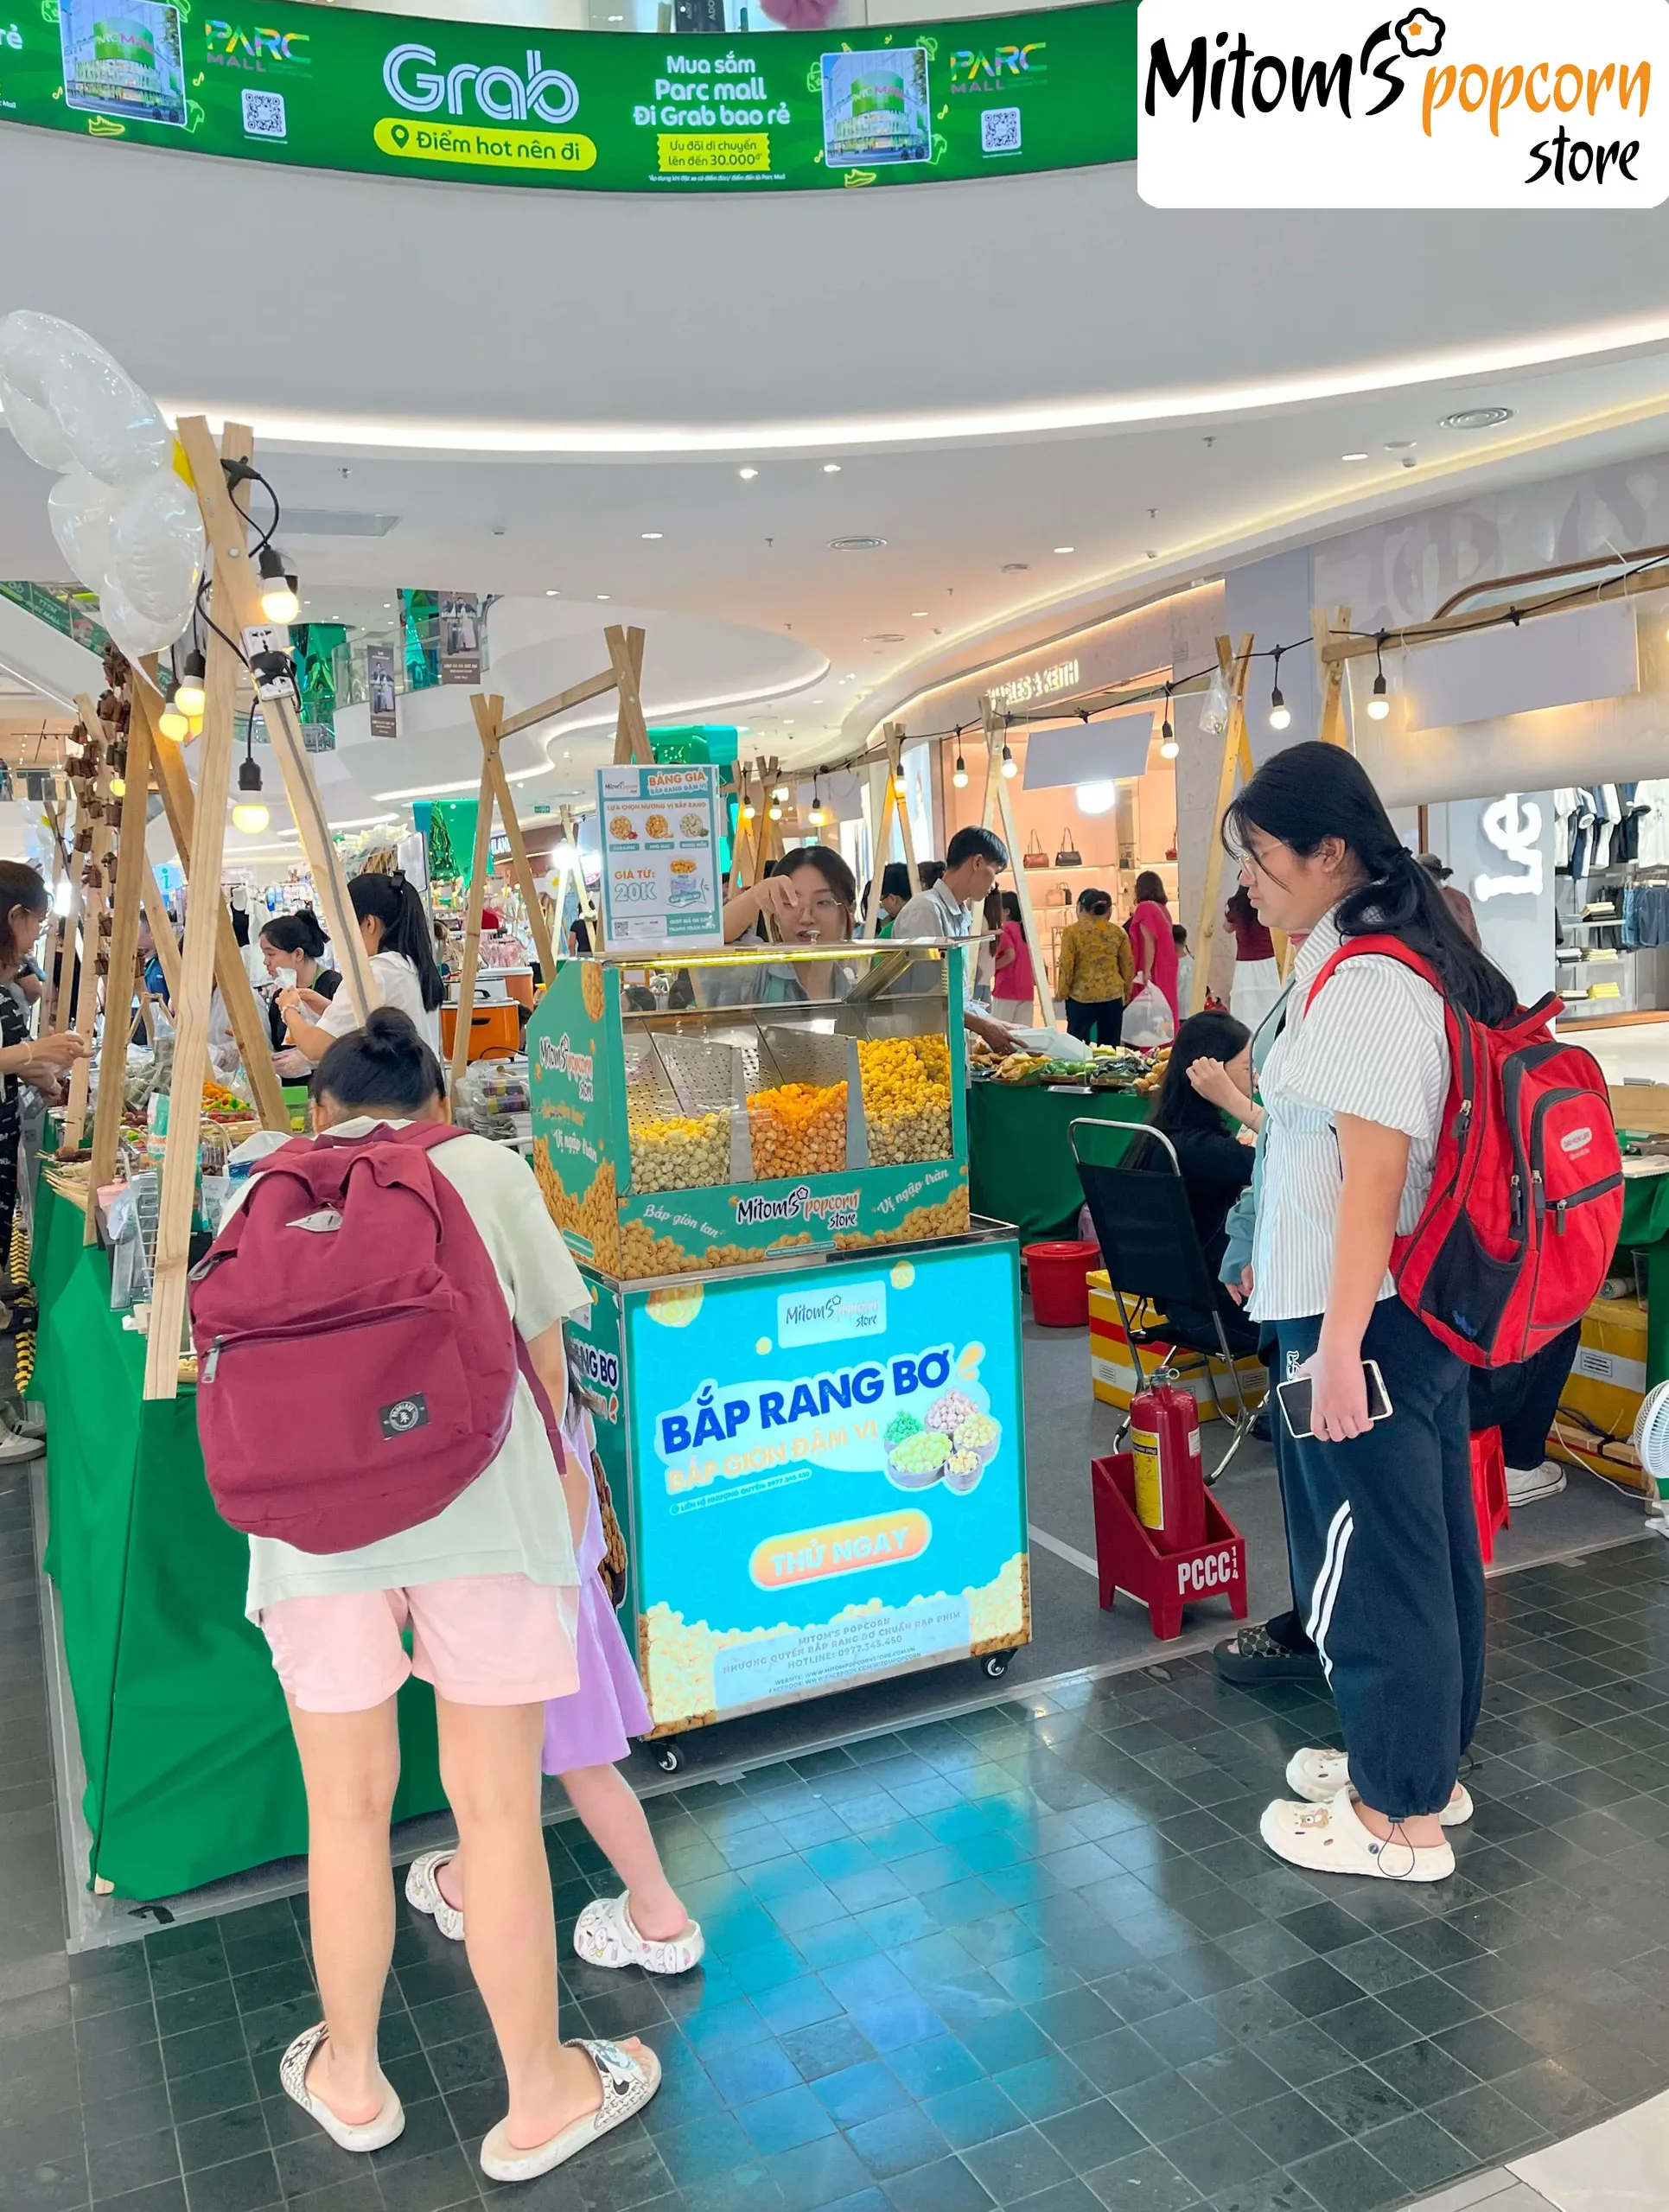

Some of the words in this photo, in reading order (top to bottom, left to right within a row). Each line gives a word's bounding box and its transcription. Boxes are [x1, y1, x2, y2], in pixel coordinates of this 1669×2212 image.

[205, 19, 310, 64] PARC
[207, 52, 267, 73] MALL
[666, 55, 710, 73] Mua
[715, 50, 755, 73] sắm
[950, 41, 1045, 81] PARC
[383, 43, 579, 124] Grab
[655, 78, 710, 100] Parc
[714, 77, 768, 100] mall
[951, 81, 1005, 94] MALL
[633, 105, 657, 126] Đi
[660, 105, 717, 126] Grab
[720, 105, 764, 126] bao
[768, 102, 791, 125] rẻ
[416, 131, 471, 153] Điểm
[476, 137, 512, 156] hot
[518, 141, 556, 160] nên
[561, 143, 580, 161] đi
[669, 140, 685, 151] Ưu
[686, 140, 704, 151] đãi
[668, 155, 685, 166] lên
[688, 155, 708, 166] đến
[649, 772, 682, 786] BẢNG
[685, 768, 705, 781] GIÁ
[615, 868, 634, 880] GIÁ
[637, 866, 654, 878] TỪ:
[615, 882, 657, 902] 20K
[895, 1181, 923, 1203] ngập
[925, 1170, 949, 1185] tràn
[643, 1204, 671, 1221] Bắp
[672, 1214, 698, 1228] giòn
[805, 1194, 857, 1219] popcorn
[830, 1213, 856, 1228] store
[856, 1313, 877, 1327] store
[662, 1386, 750, 1454] BẮP
[759, 1368, 884, 1429] RANG
[892, 1349, 950, 1396] BƠ
[668, 1455, 718, 1491] BẮP
[723, 1442, 787, 1478] GIÒN
[792, 1427, 849, 1458] ĐẬM
[853, 1419, 877, 1444] VỊ
[771, 1538, 827, 1578] THỬ
[832, 1527, 908, 1564] NGAY
[1178, 1552, 1231, 1595] PCCC
[799, 1629, 840, 1646] MITOM'S
[844, 1618, 890, 1635] POPCORN
[831, 1635, 859, 1648] RANG
[936, 1611, 960, 1623] PHIM
[788, 1651, 836, 1669] HOTLINE:
[838, 1635, 902, 1658] 0977.345.450
